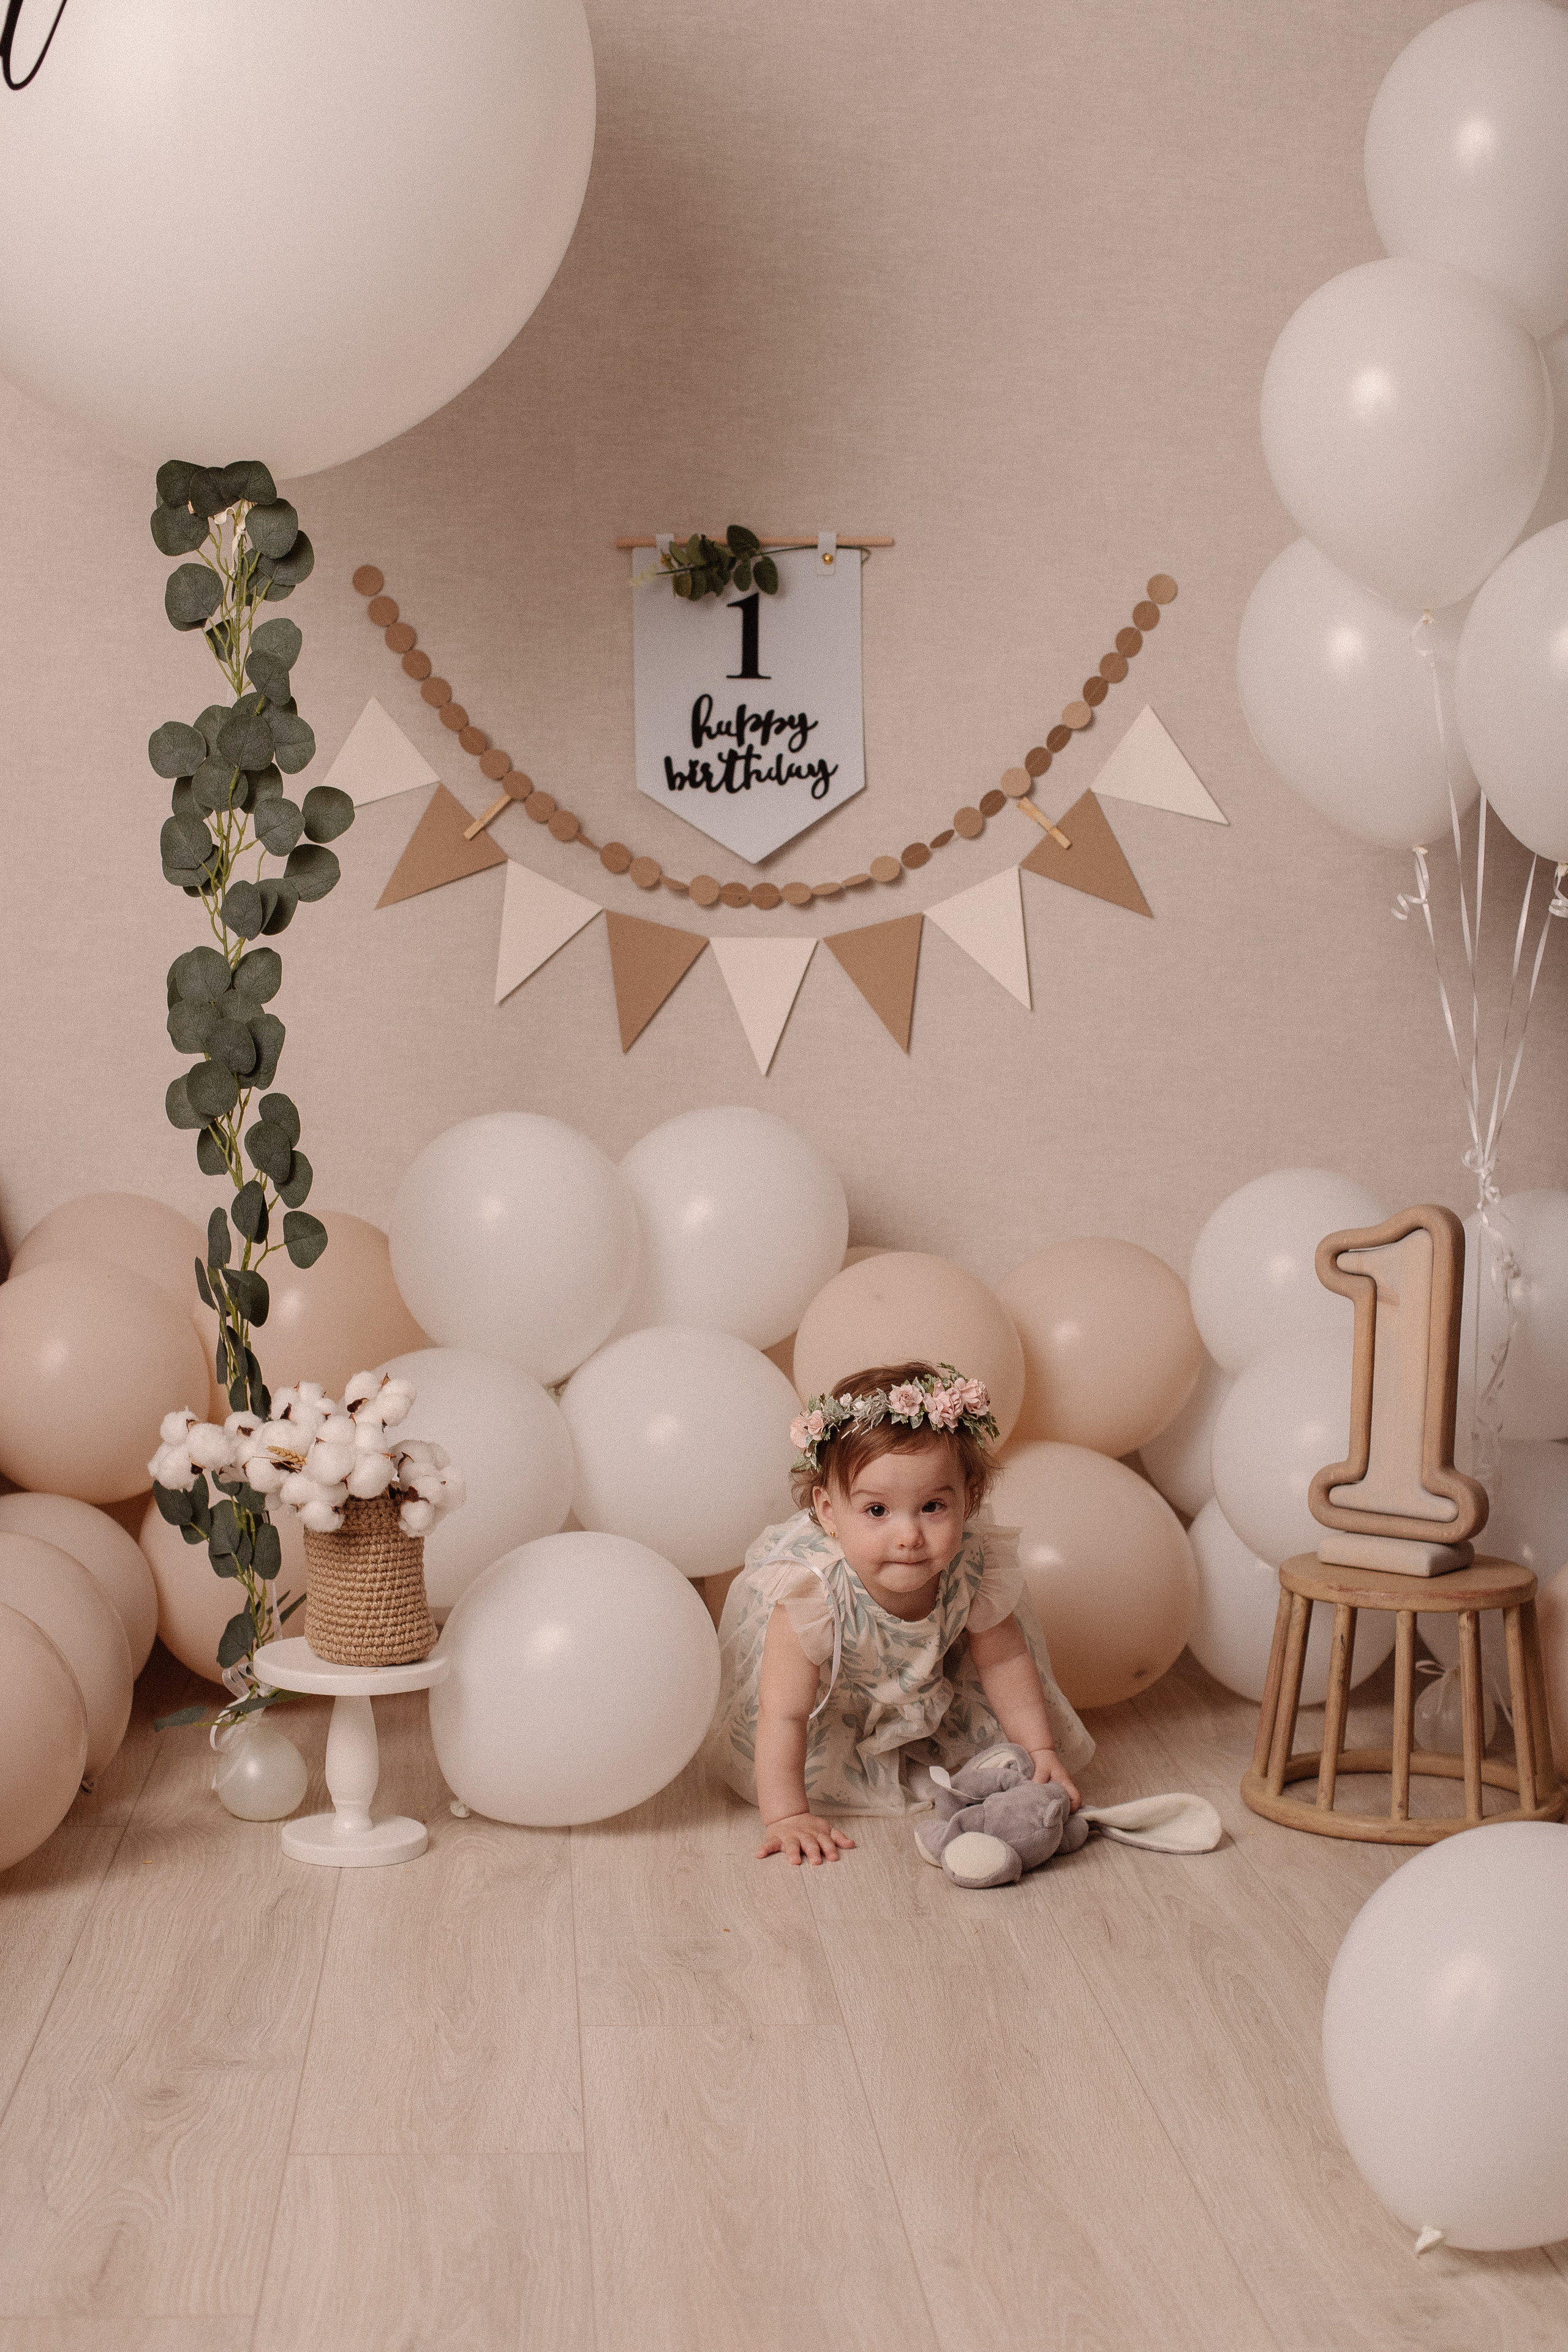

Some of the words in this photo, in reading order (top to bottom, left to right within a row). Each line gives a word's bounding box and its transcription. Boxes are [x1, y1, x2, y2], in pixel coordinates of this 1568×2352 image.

[726, 592, 772, 680] 1
[691, 693, 819, 753] happy
[663, 743, 839, 800] birthday
[1308, 1204, 1490, 1545] 1
